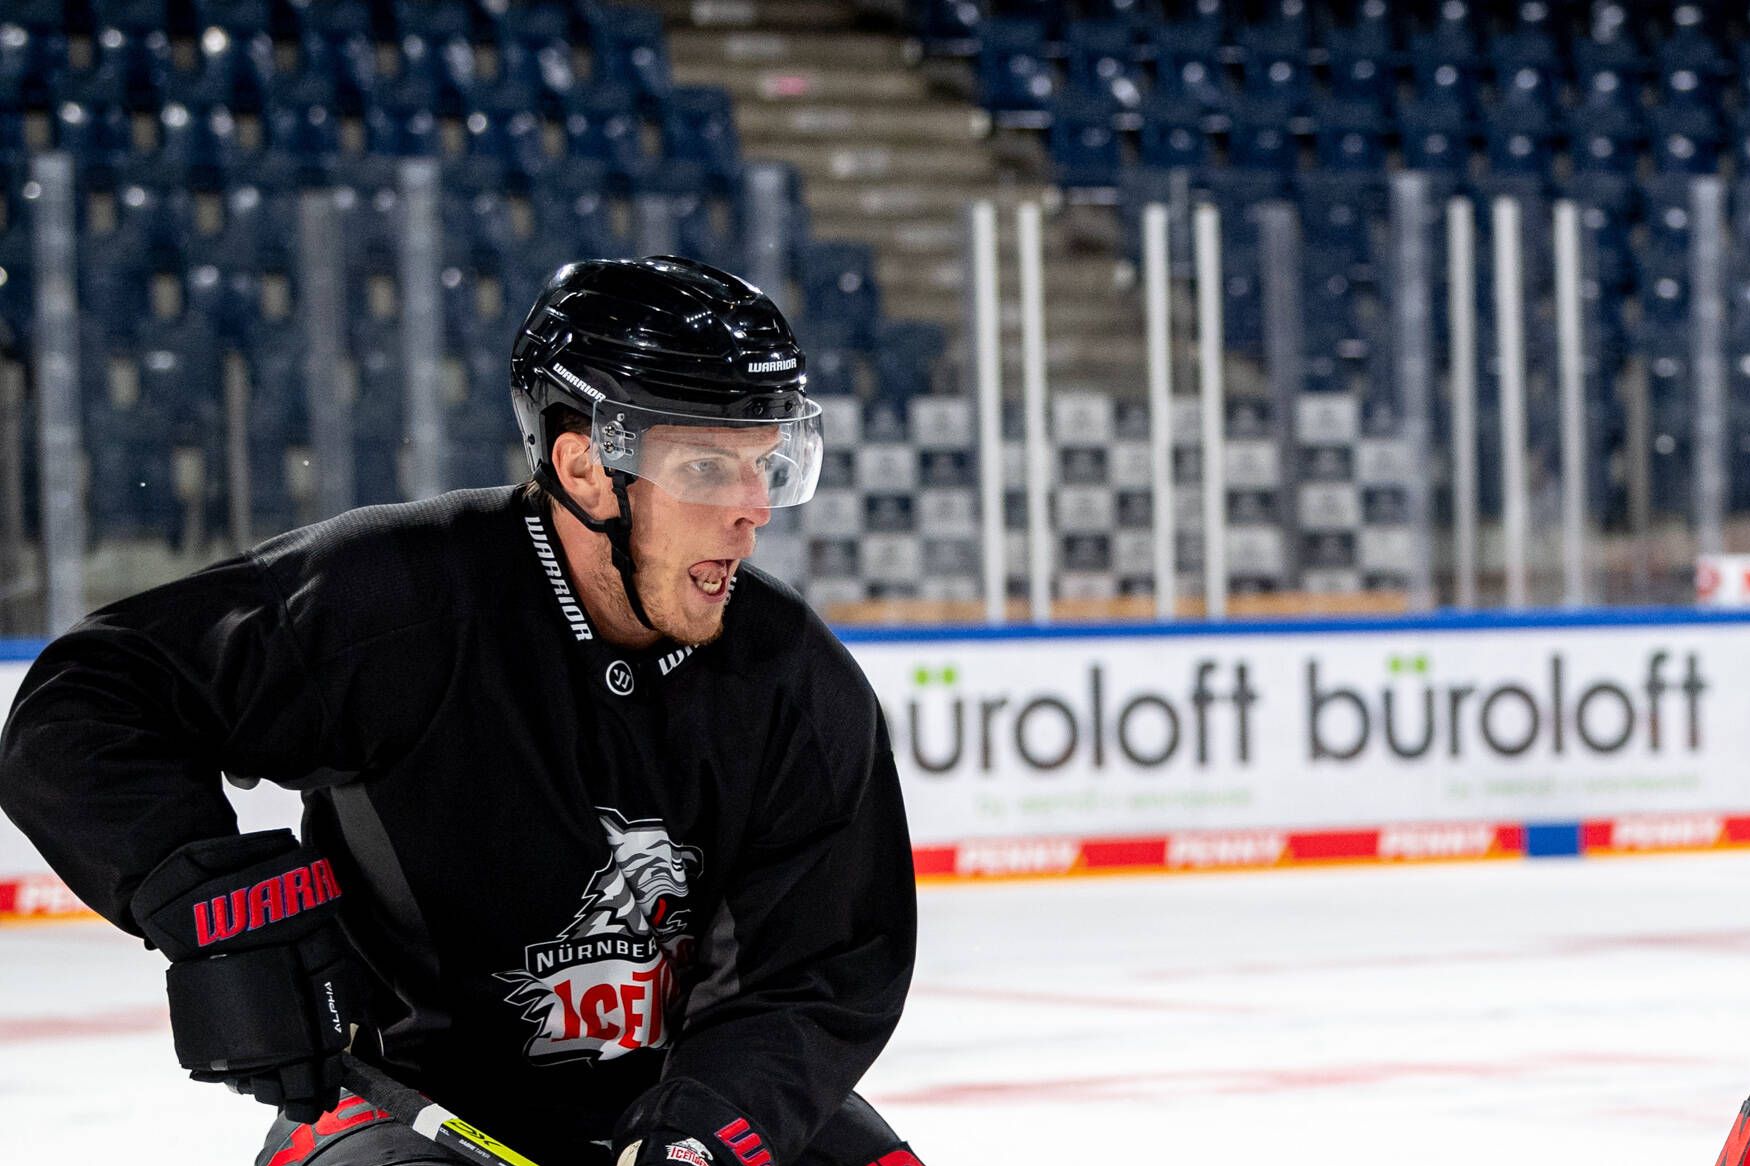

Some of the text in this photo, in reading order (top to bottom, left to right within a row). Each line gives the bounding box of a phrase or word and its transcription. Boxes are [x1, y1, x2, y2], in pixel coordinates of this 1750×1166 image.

[552, 362, 607, 401] WARRIOR
[748, 358, 797, 373] WARRIOR
[524, 516, 594, 642] WARRIOR
[895, 660, 1258, 774] üroloft
[1307, 650, 1706, 761] büroloft
[325, 981, 342, 1034] ALPHA
